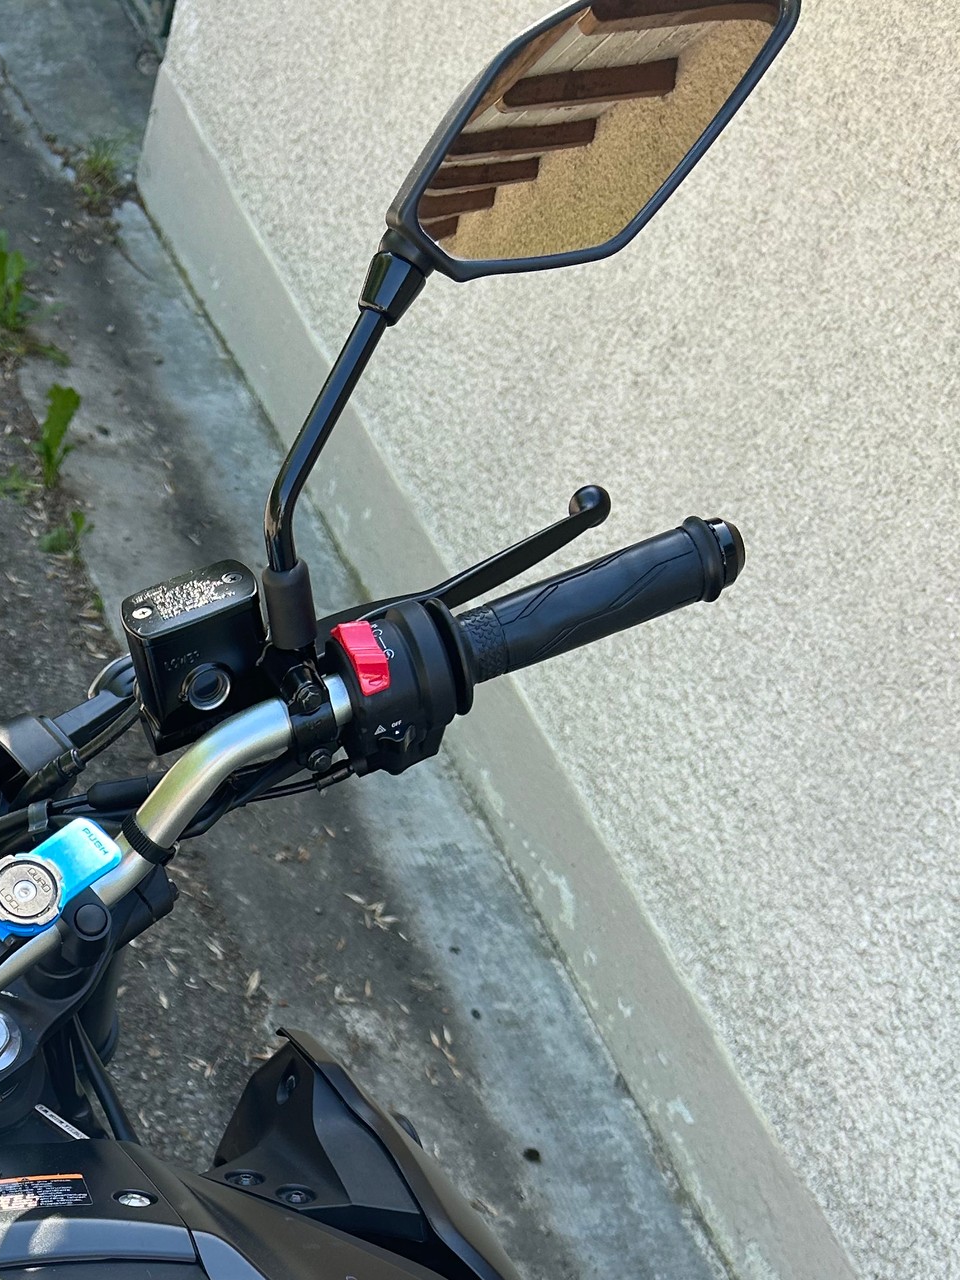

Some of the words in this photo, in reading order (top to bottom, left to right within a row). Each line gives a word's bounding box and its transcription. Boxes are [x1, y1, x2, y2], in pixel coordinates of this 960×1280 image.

[391, 719, 402, 728] OFF
[82, 827, 109, 856] PUSH
[27, 867, 51, 893] QUAD
[0, 888, 23, 913] LOCK
